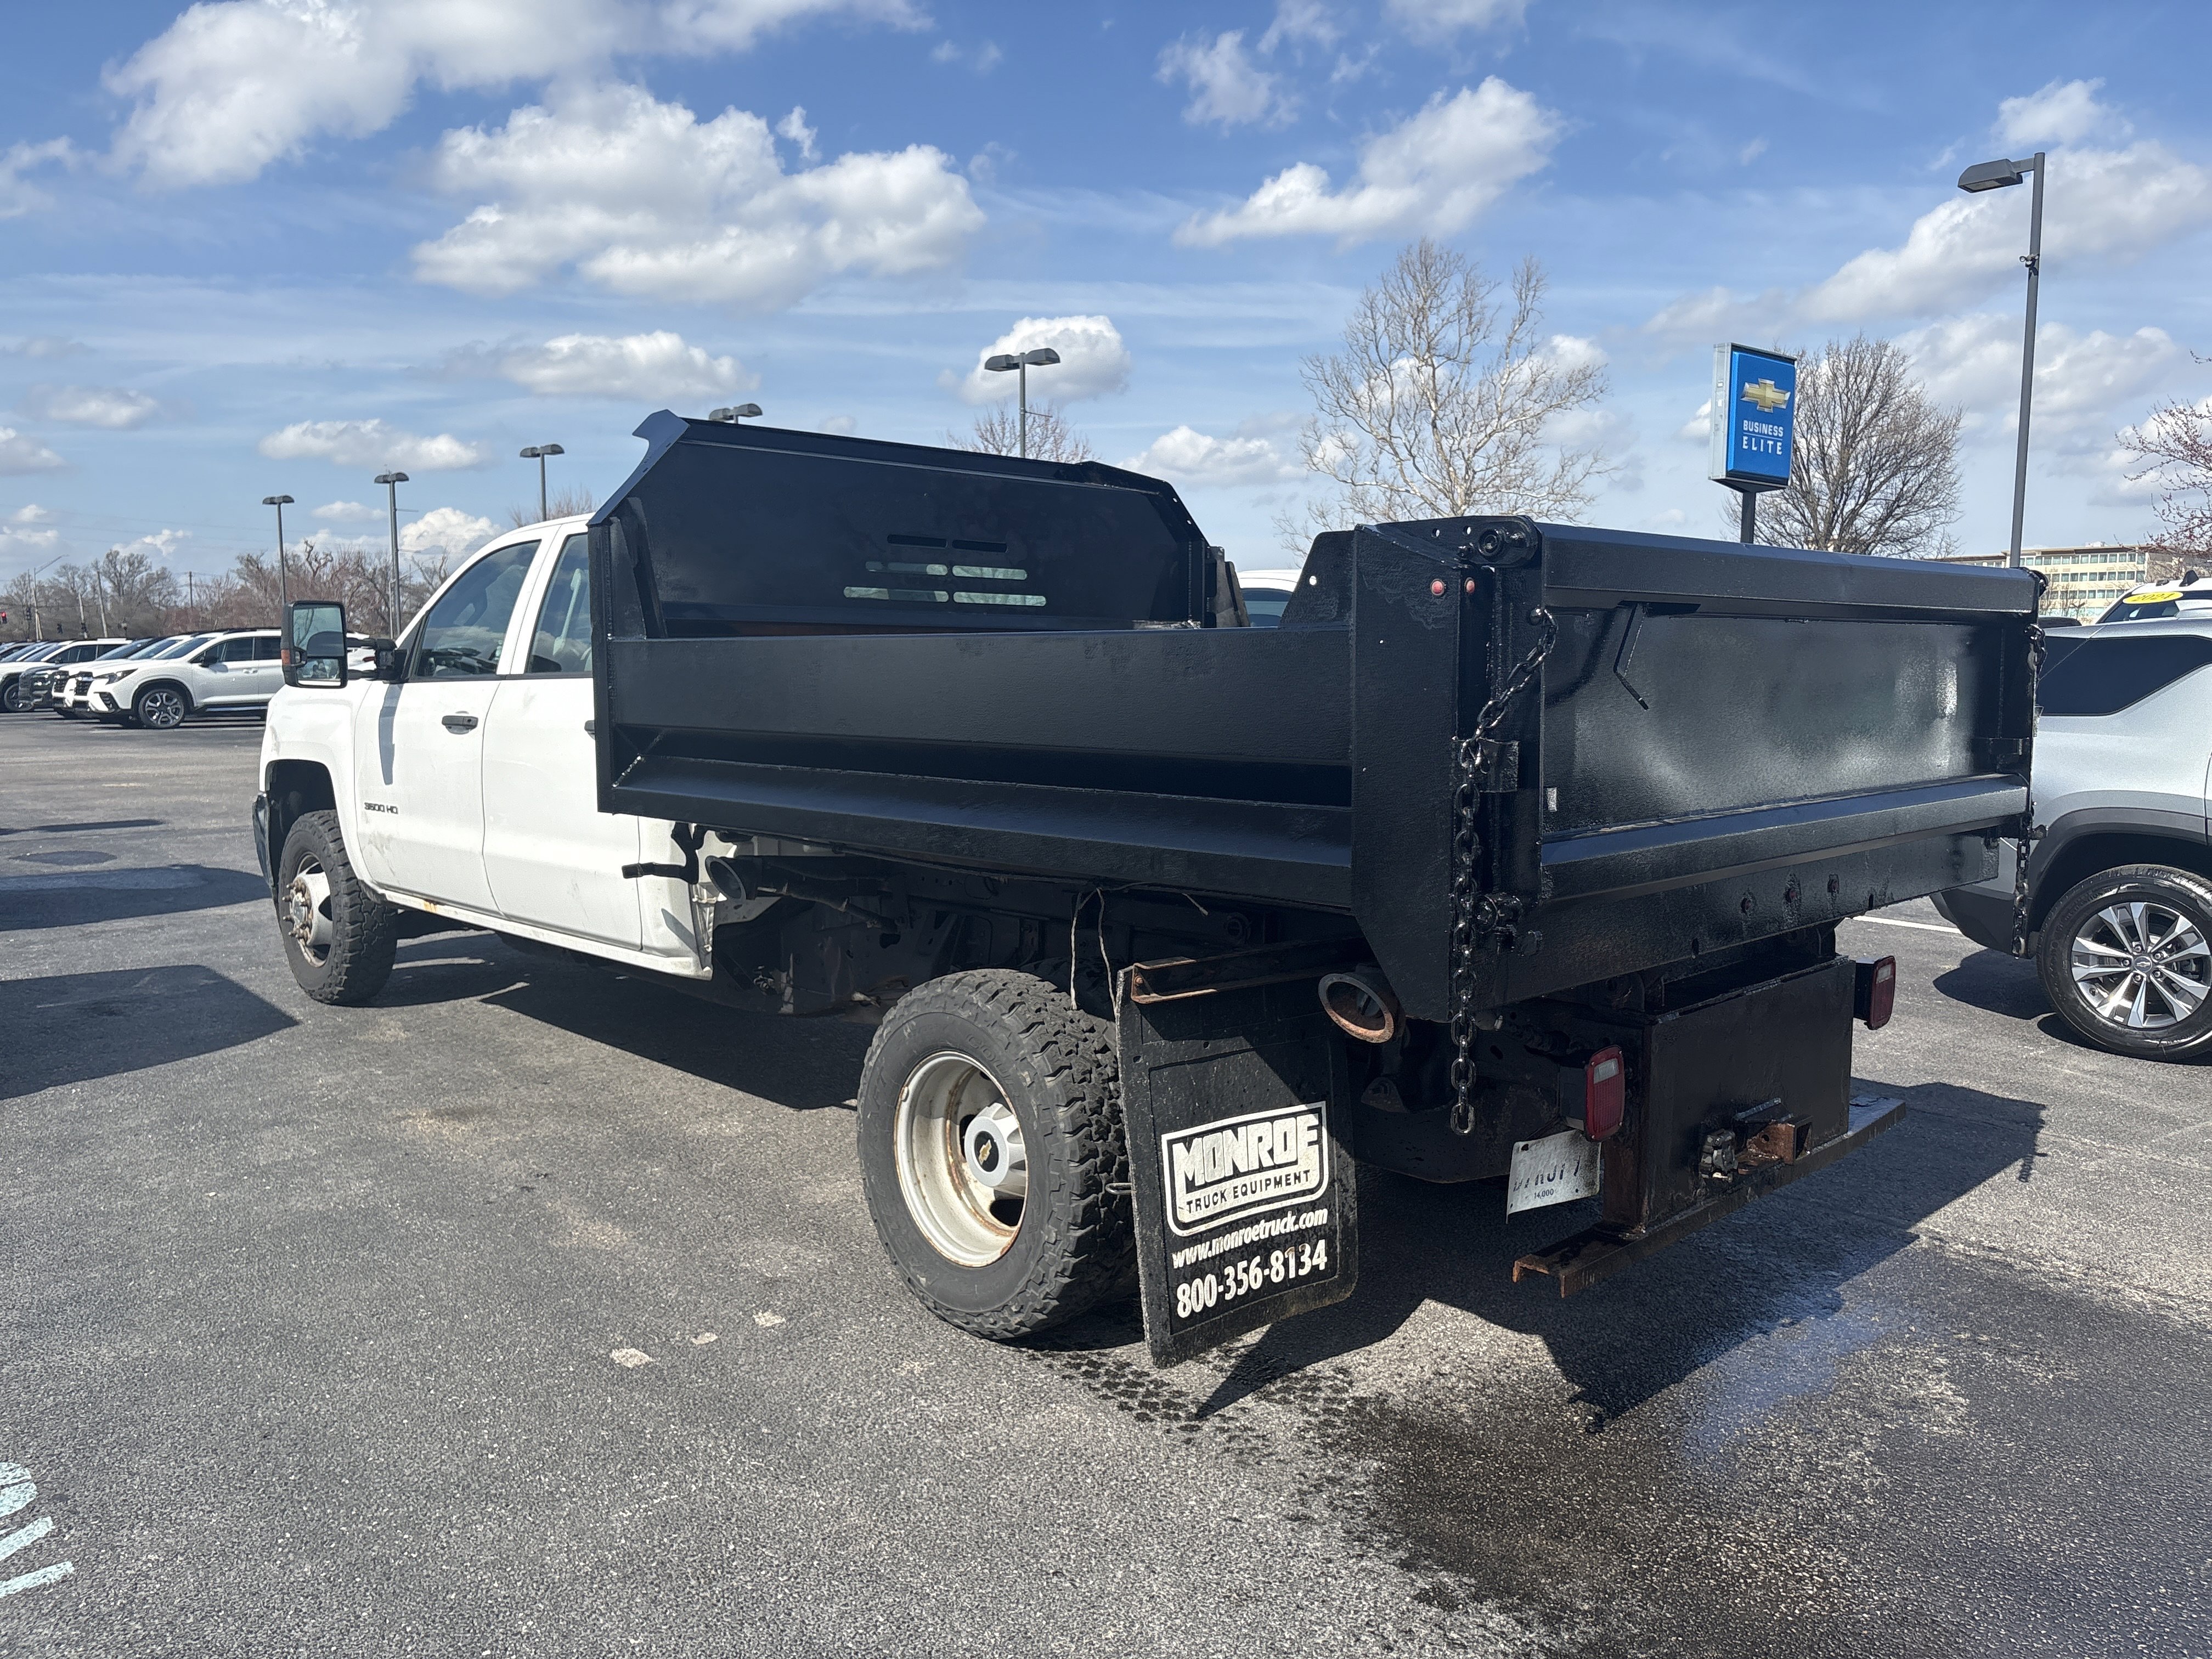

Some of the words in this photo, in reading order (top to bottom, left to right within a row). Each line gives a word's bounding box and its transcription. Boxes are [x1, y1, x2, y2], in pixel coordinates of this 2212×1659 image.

[1743, 420, 1784, 436] BUSINESS
[1743, 437, 1782, 455] ELITE
[364, 802, 385, 812] 3500
[386, 805, 399, 814] HD
[1172, 1114, 1318, 1186] MONROE
[1187, 1189, 1227, 1214] TRUCK
[1234, 1170, 1310, 1199] EQUIPMENT
[1534, 1188, 1554, 1199] 14,000
[1173, 1209, 1328, 1269] www.monroetruck.com
[1177, 1240, 1327, 1318] 800-356-8134
